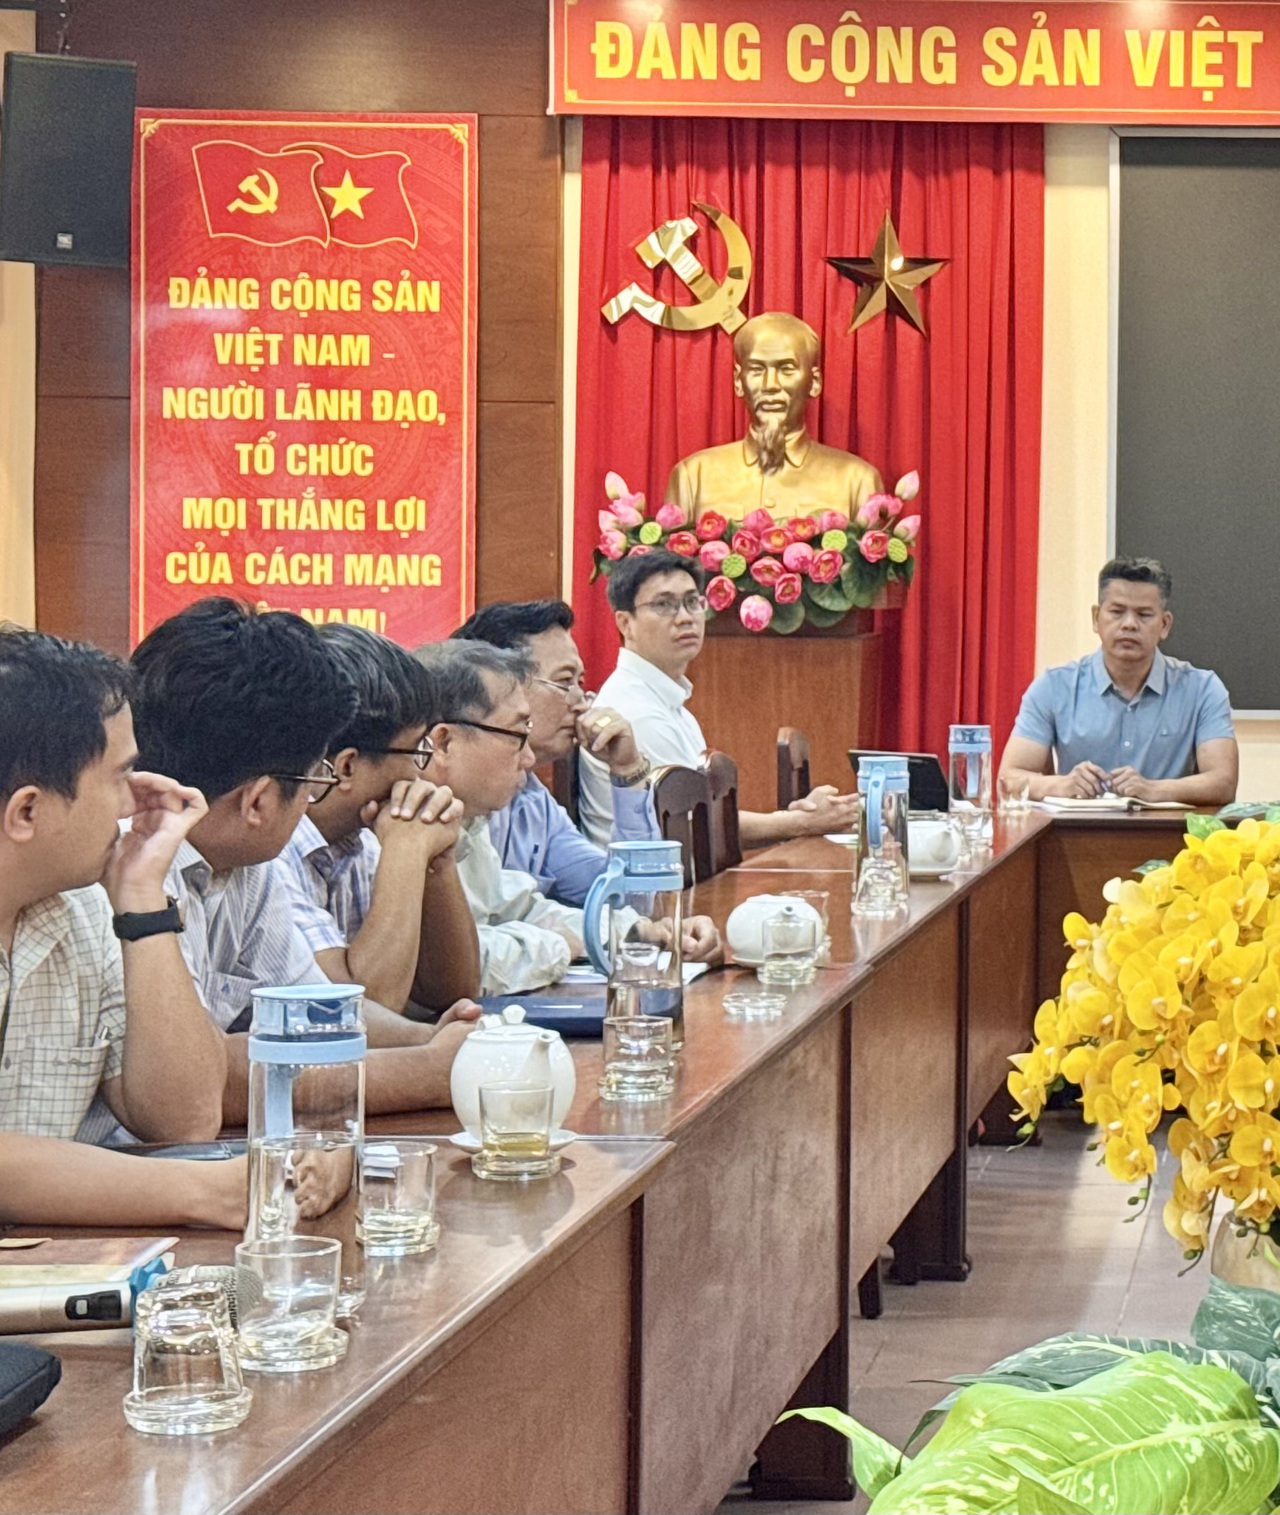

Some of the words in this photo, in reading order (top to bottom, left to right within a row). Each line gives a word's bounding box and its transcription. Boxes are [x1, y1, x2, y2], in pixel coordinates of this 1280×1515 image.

[591, 6, 762, 81] ĐẢNG
[786, 12, 957, 98] CỘNG
[981, 12, 1102, 88] SẢN
[1123, 15, 1264, 101] VIỆT
[168, 267, 260, 311] ĐẢNG
[270, 273, 362, 317] CỘNG
[372, 270, 441, 313] SẢN
[214, 326, 284, 372] VIỆT
[293, 335, 371, 367] NAM
[162, 380, 265, 421] NGƯỜI
[275, 383, 362, 422] LÃNH
[371, 389, 447, 428] ĐẠO,
[235, 431, 278, 476] TỔ
[286, 437, 375, 477] CHỨC
[182, 497, 247, 537] MỌI
[257, 487, 367, 532] THẮNG
[377, 497, 427, 539] LỢI
[165, 542, 234, 586] CỦA
[245, 547, 334, 587] CÁCH
[344, 554, 442, 592] MẠNG
